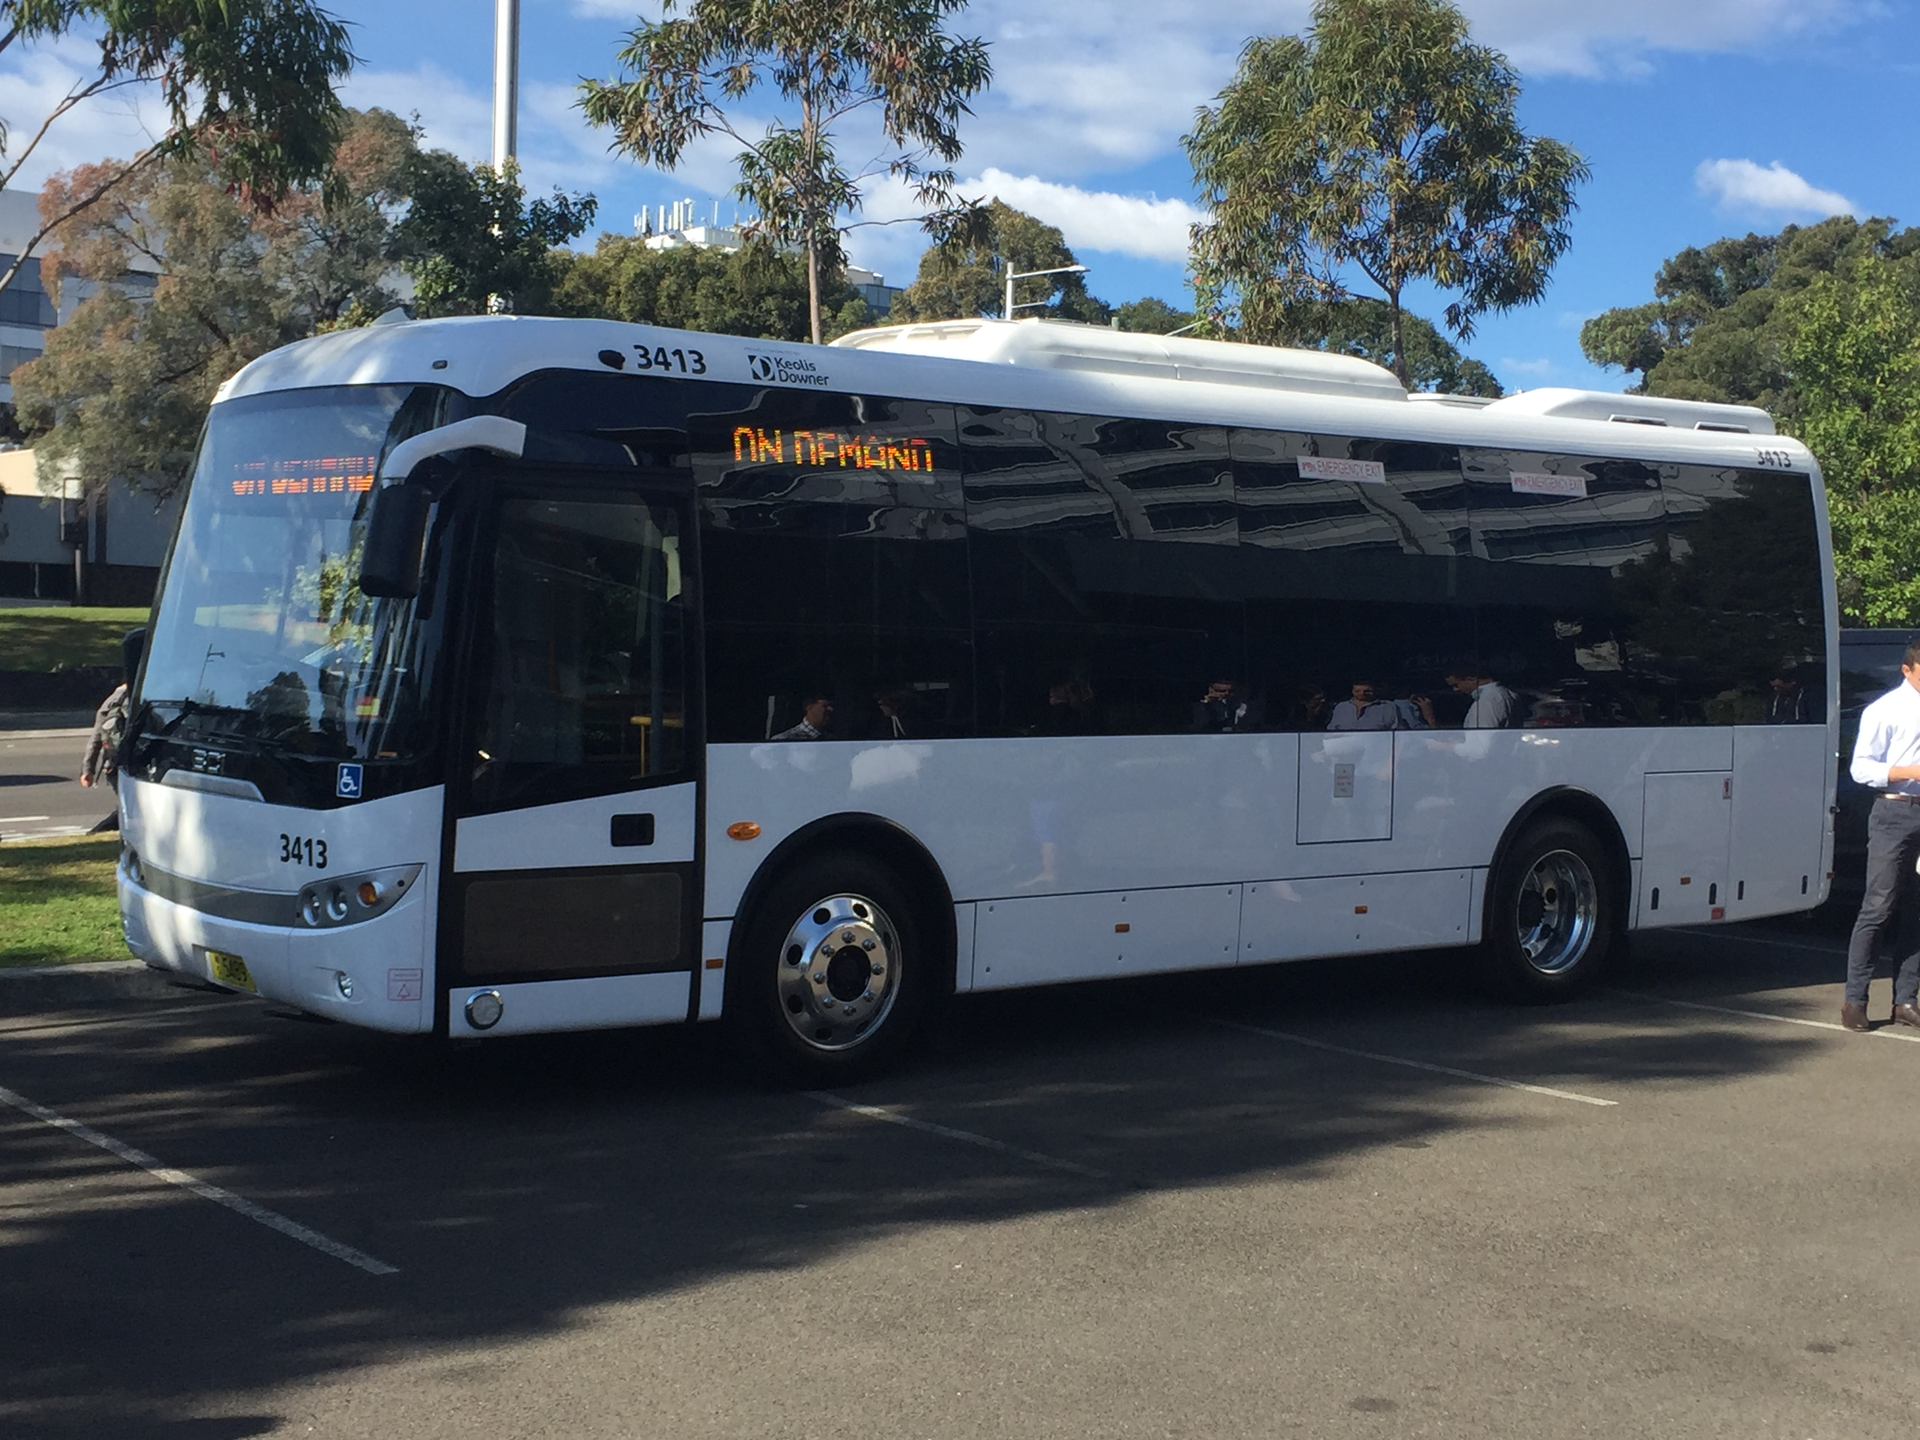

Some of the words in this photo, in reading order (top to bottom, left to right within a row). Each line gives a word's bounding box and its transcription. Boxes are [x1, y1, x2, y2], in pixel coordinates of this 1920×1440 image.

[632, 344, 707, 375] 3413
[774, 356, 816, 372] Keolis
[778, 369, 829, 386] Downer
[279, 833, 328, 869] 3413
